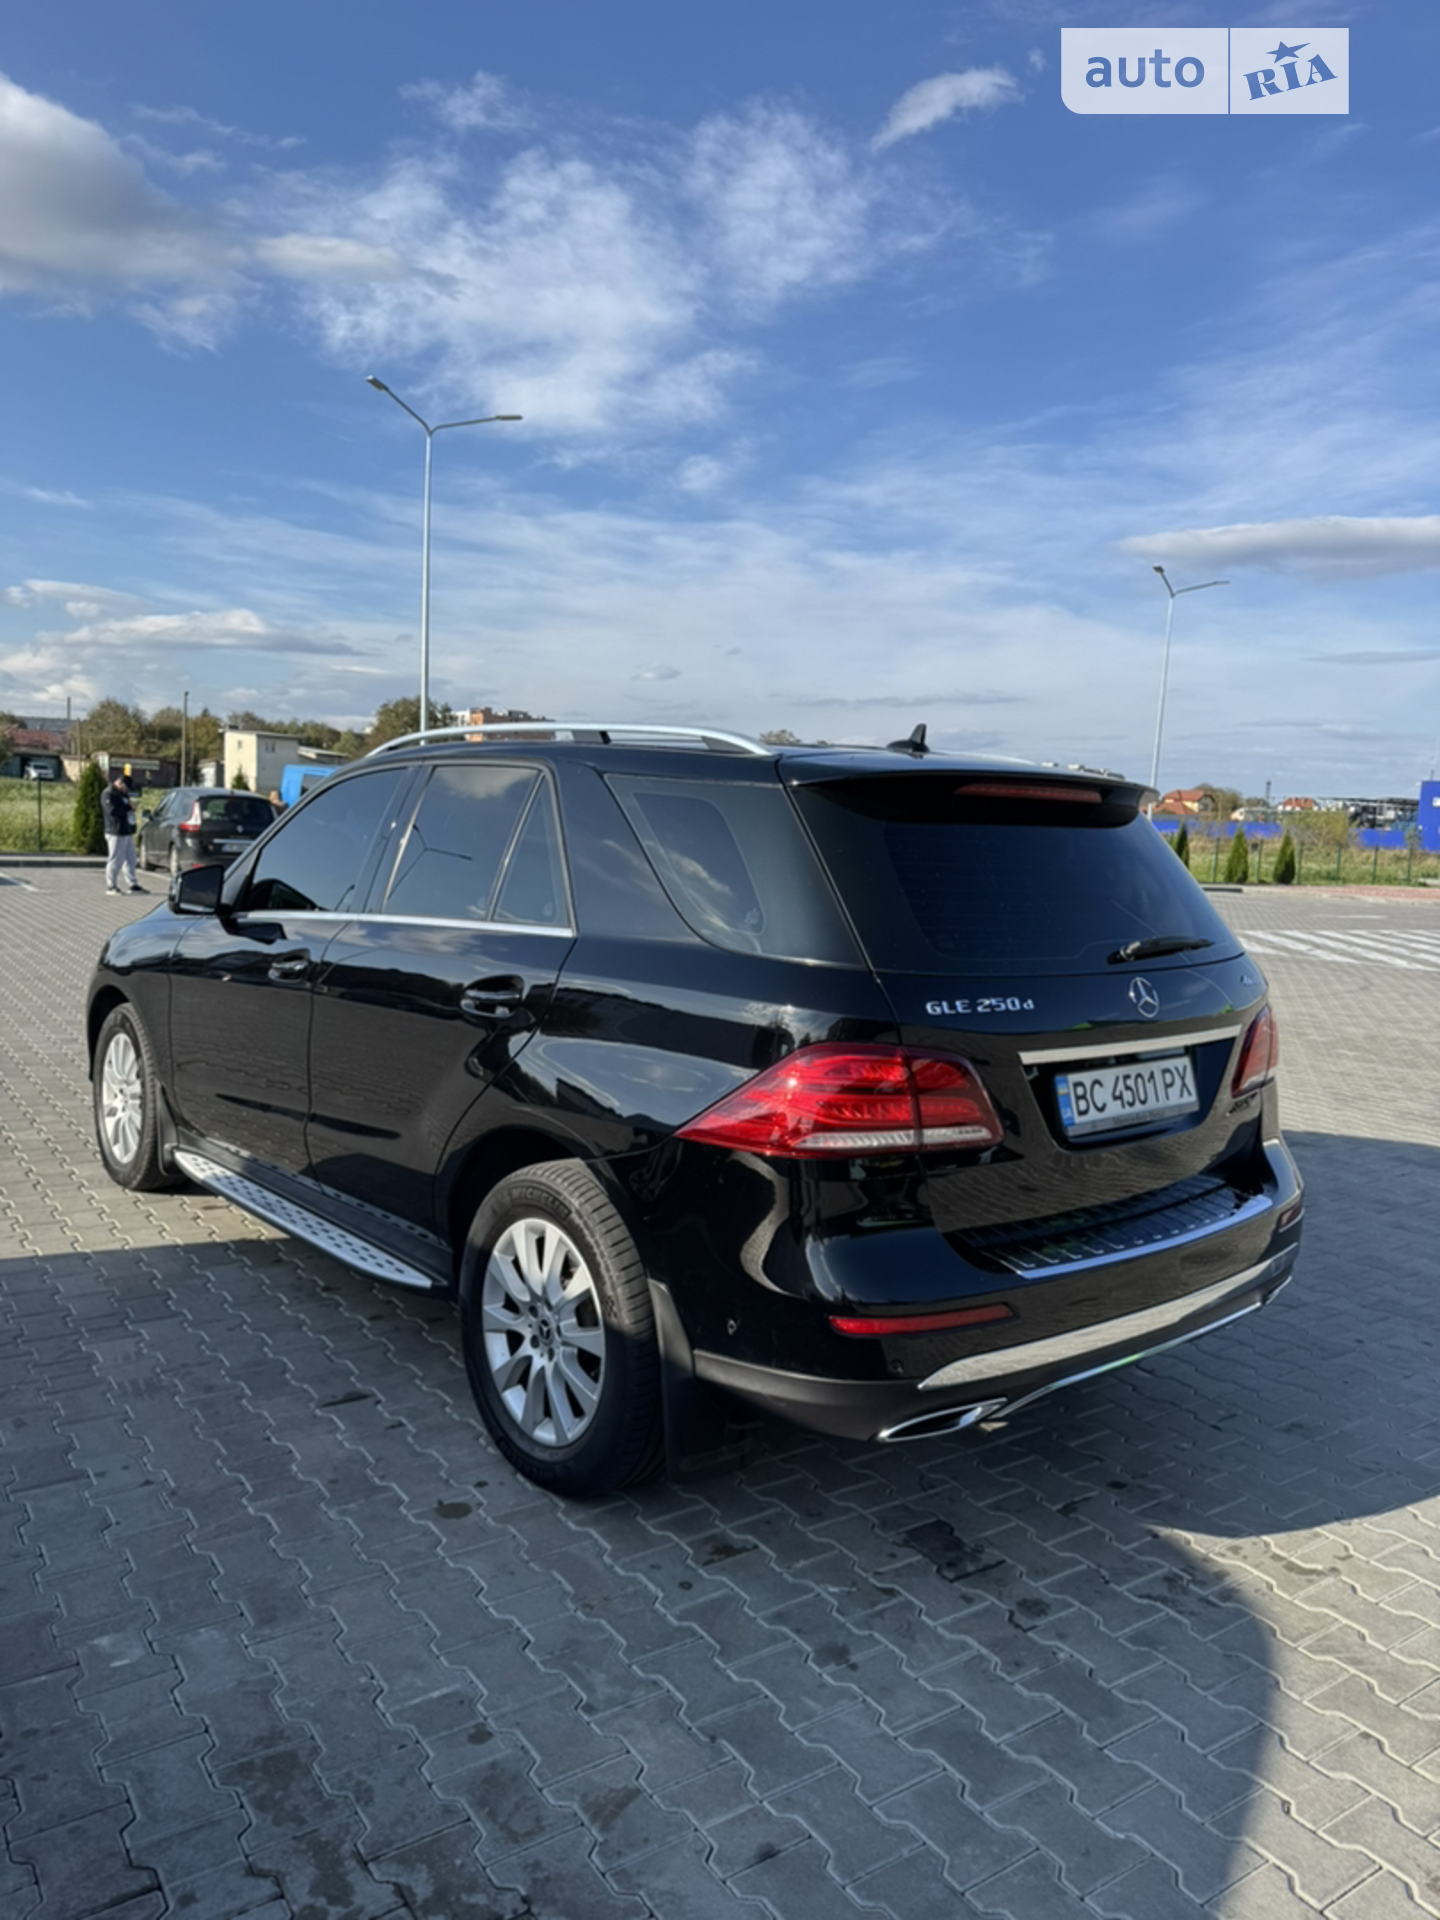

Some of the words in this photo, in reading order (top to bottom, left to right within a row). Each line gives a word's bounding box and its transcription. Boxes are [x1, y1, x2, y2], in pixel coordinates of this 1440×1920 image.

[925, 999, 972, 1016] GLE
[1072, 1078, 1107, 1118] BC
[1111, 1070, 1160, 1110] 4501
[1160, 1064, 1193, 1102] PX
